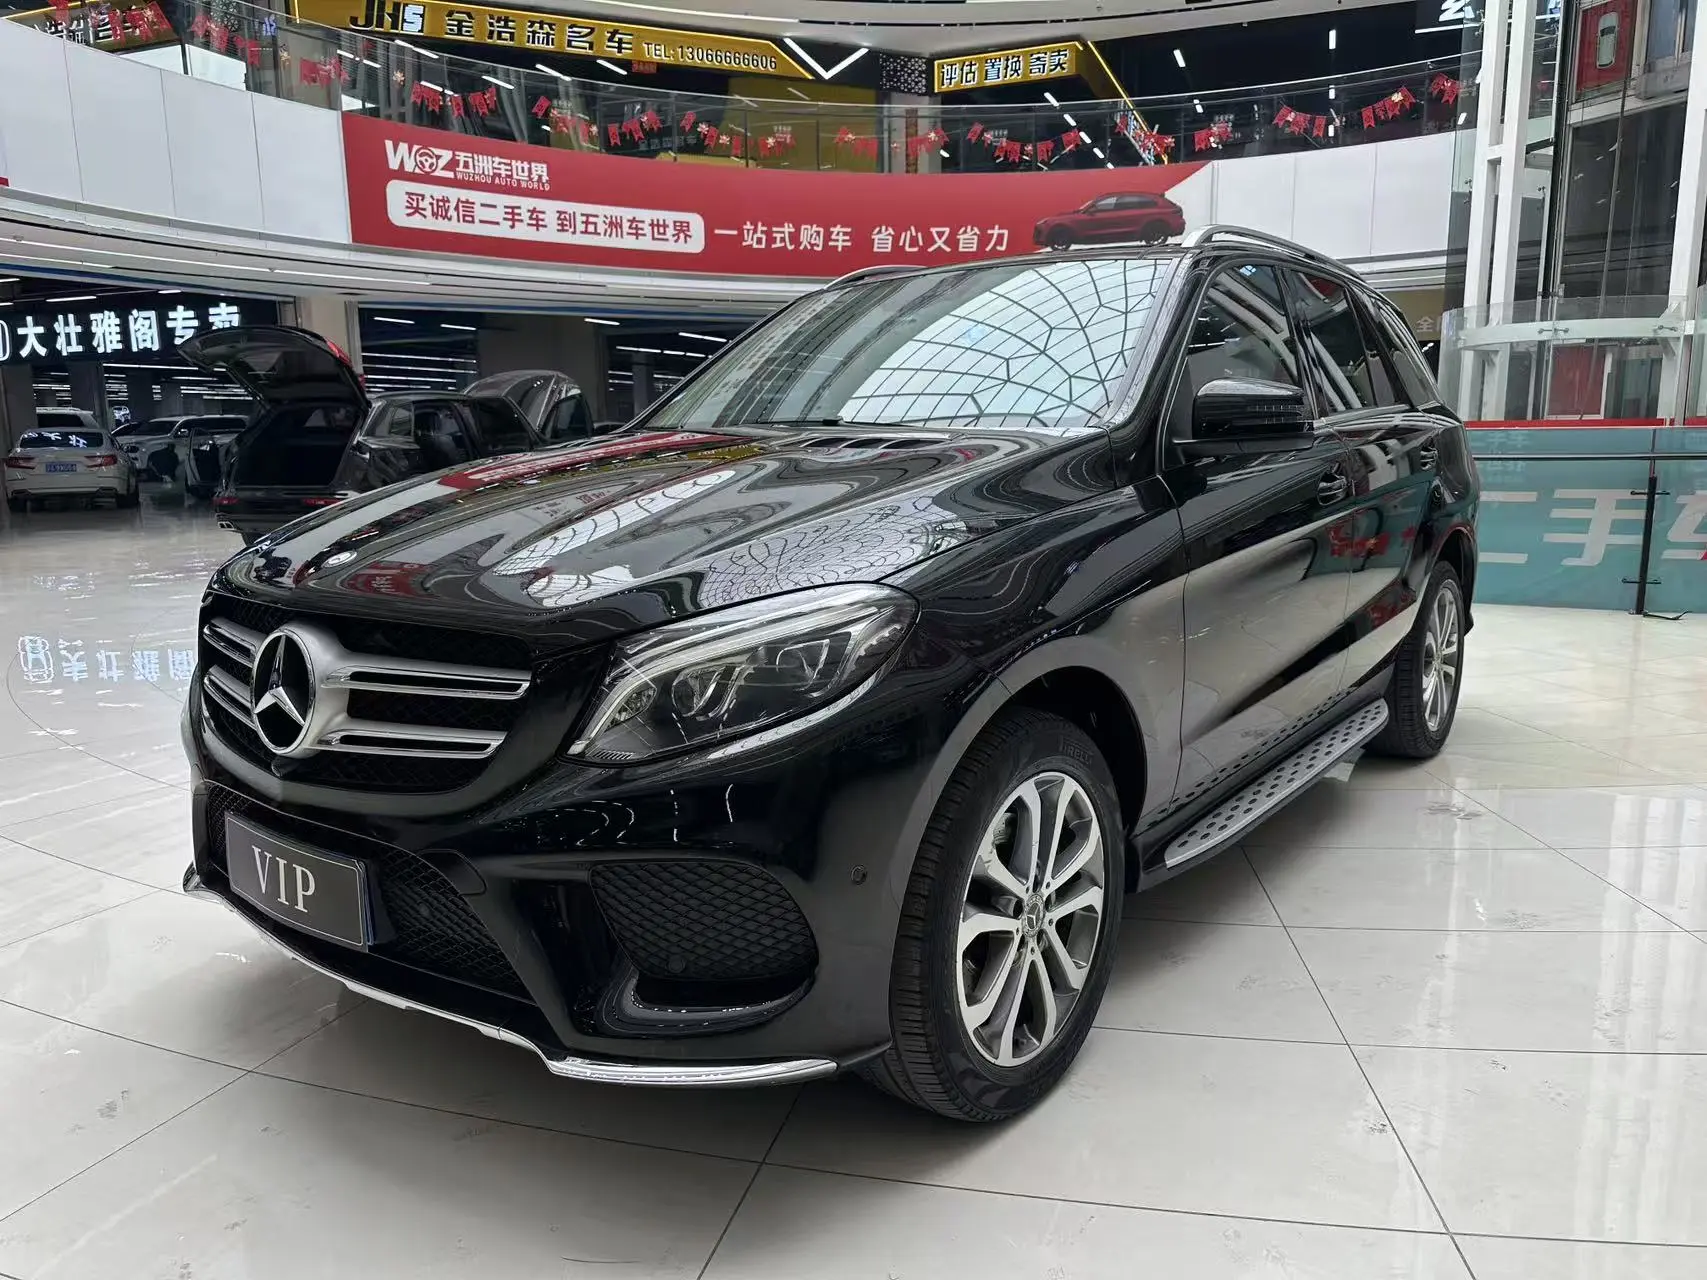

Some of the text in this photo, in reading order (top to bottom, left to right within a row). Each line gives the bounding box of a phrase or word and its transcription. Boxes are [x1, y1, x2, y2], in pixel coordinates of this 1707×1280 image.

[444, 10, 633, 55] 金浩森名车
[941, 49, 1069, 88] 评估 置换 寄卖
[455, 151, 550, 183] 五洲车世界
[456, 172, 551, 191] WUZHOU AUTO WORLD
[404, 191, 692, 244] 买诚信二手车 到五洲车世界
[714, 222, 1010, 253] 一站式购车 省心又省力
[252, 845, 315, 913] VIP
